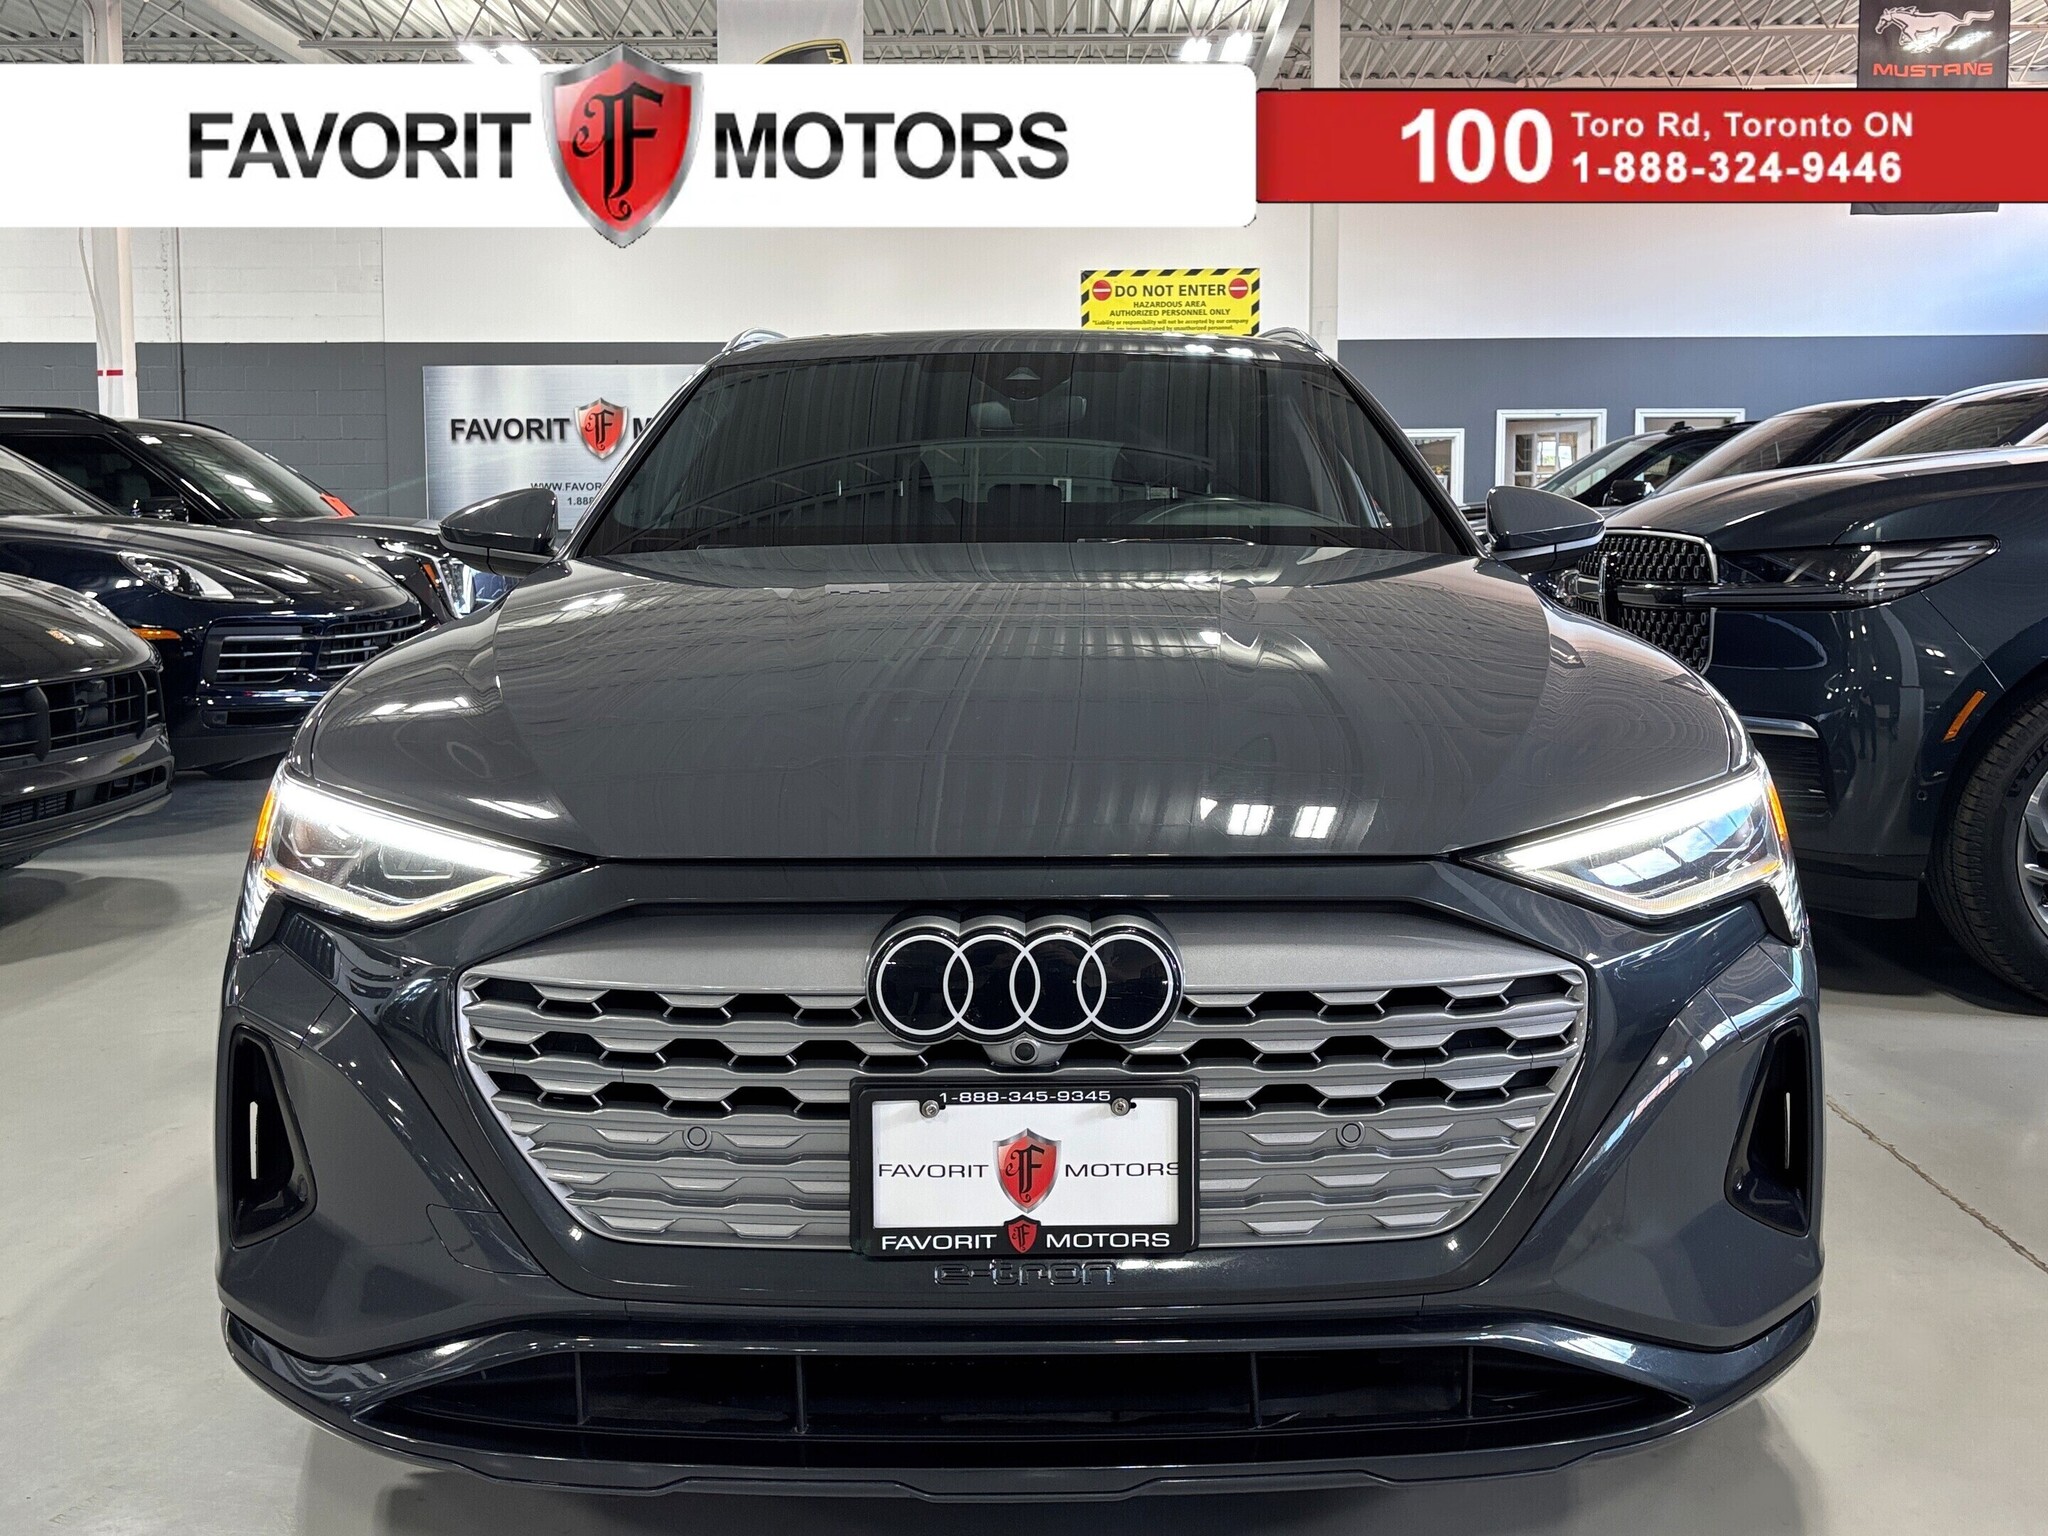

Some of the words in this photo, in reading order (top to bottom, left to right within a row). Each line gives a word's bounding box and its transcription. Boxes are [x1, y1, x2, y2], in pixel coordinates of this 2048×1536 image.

[1873, 62, 1993, 77] MUSTANG
[1115, 285, 1137, 297] DO
[1143, 285, 1174, 297] NOT
[1179, 284, 1226, 296] ENTER
[1110, 309, 1159, 317] AUTHORIZED
[1210, 308, 1231, 316] ONLY
[450, 418, 570, 441] FAVORIT
[939, 1090, 1111, 1103] 1-888-345-9345
[879, 1163, 989, 1178] FAVORIT
[1065, 1162, 1178, 1178] MOTORS
[881, 1233, 998, 1250] FAVORIT
[1046, 1232, 1170, 1249] MOTORS
[933, 1260, 1117, 1286] e-tron
